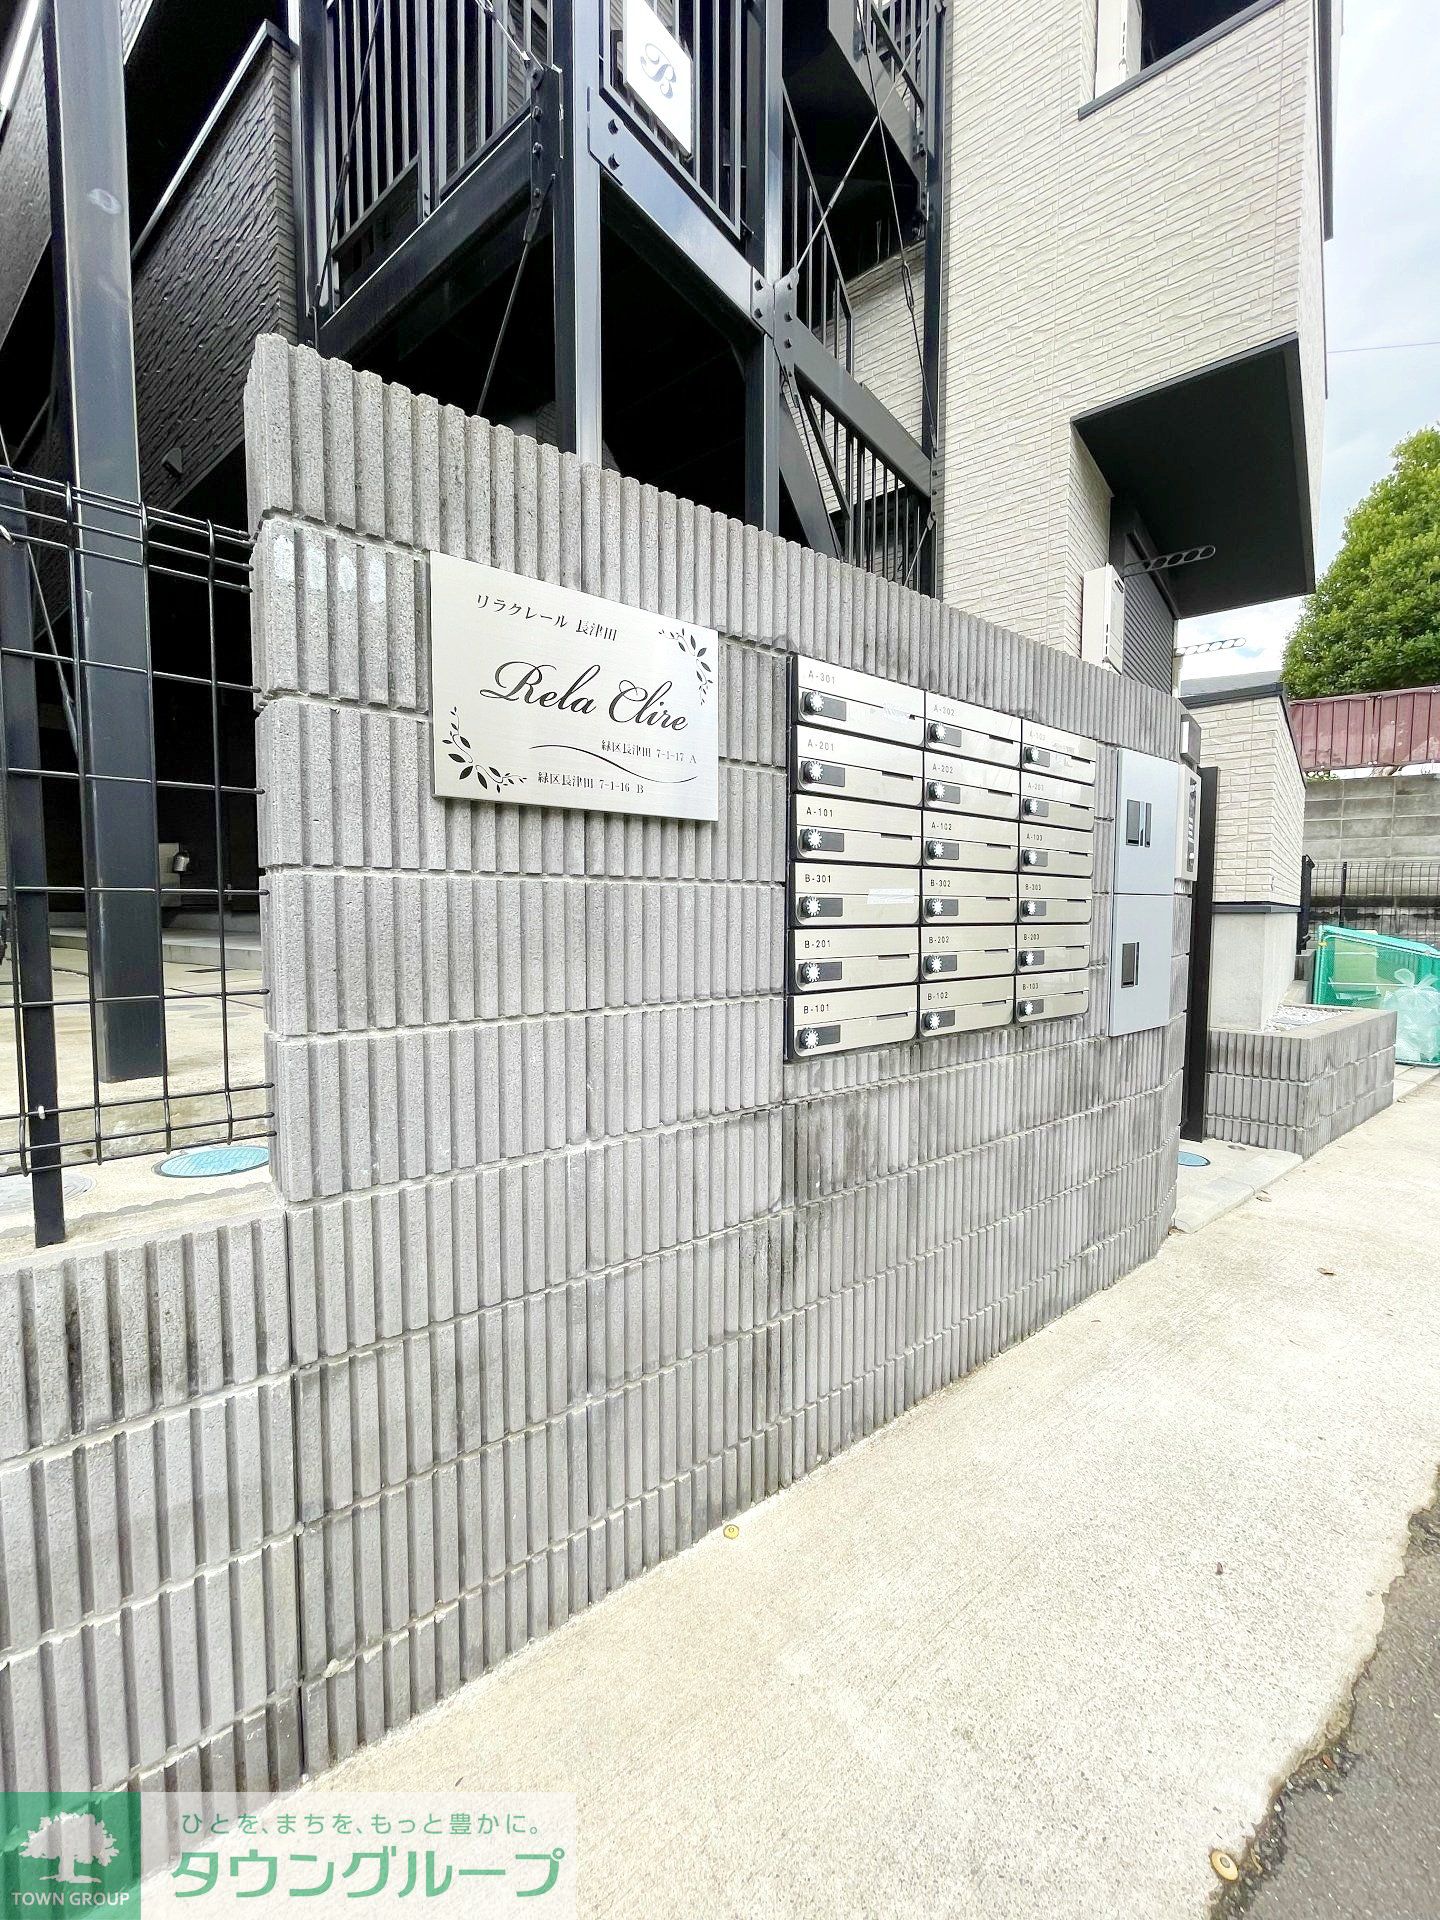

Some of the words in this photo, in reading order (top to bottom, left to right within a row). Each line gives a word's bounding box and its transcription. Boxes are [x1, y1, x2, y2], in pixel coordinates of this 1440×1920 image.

[477, 594, 568, 628] リラクレール
[575, 619, 618, 641] 長津田
[808, 669, 836, 685] A-301
[479, 661, 601, 715] Rela
[608, 679, 689, 732] Clire
[807, 738, 835, 752] A-201
[689, 754, 697, 764] A
[932, 762, 954, 775] A-202
[537, 771, 595, 790] 緑区長津田
[599, 779, 631, 793] 7-1-16
[636, 784, 645, 794] B
[806, 806, 834, 818] A-101
[931, 821, 953, 831] A-102
[1026, 832, 1043, 842] A-103
[804, 873, 832, 884] B-301
[930, 879, 951, 888] B-302
[928, 936, 949, 944] B-202
[1023, 933, 1040, 941] B-203
[804, 939, 831, 949] B-201
[1022, 982, 1039, 991] B-103
[927, 991, 949, 1001] B-102
[803, 1003, 830, 1014] B-101
